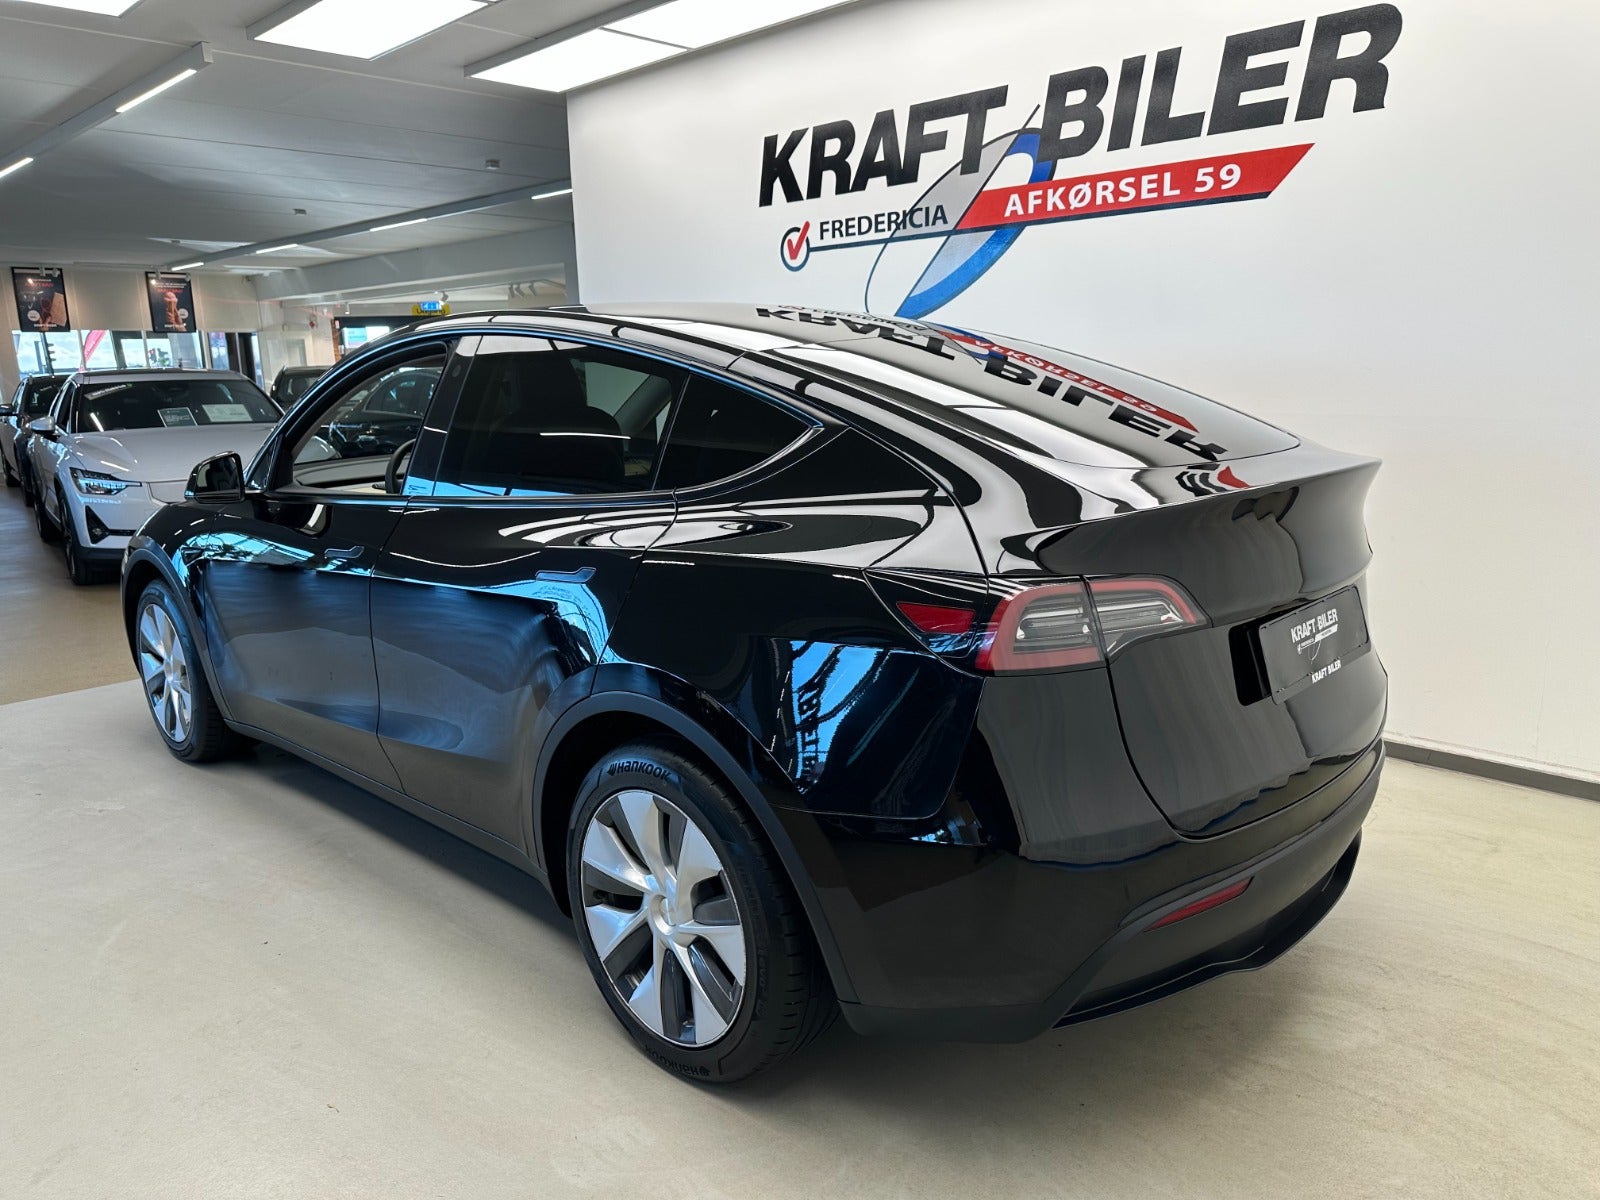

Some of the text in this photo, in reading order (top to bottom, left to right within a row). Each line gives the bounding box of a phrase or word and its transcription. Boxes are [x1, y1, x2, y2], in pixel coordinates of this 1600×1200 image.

[758, 3, 1403, 207] KRAFT BILER
[1003, 163, 1242, 217] AFKØRSEL 59
[819, 204, 948, 240] FREDERICIA
[1290, 618, 1316, 643] KRAFT
[1316, 608, 1339, 631] BILER
[1311, 659, 1342, 684] KRAFT BILER
